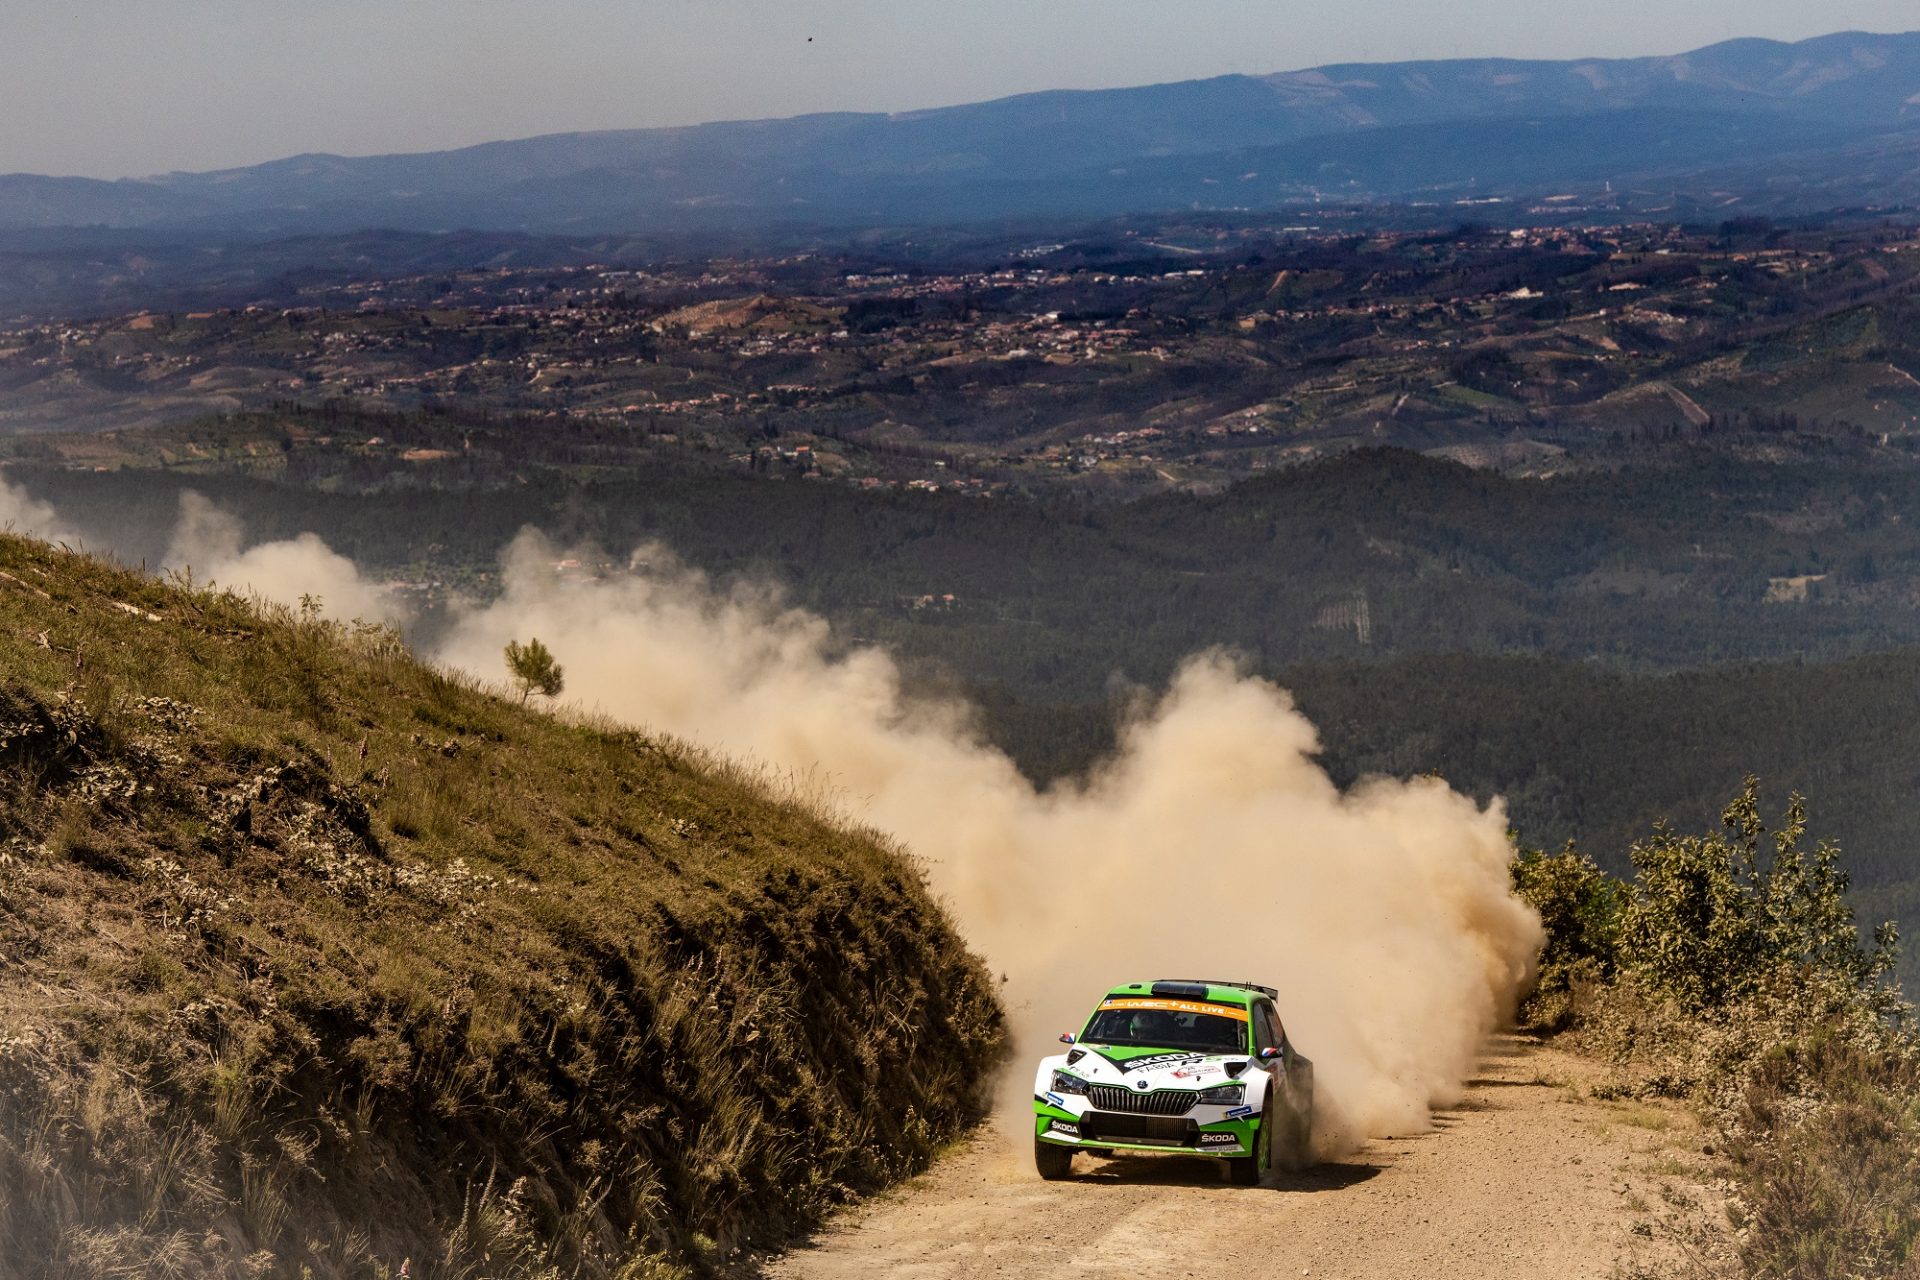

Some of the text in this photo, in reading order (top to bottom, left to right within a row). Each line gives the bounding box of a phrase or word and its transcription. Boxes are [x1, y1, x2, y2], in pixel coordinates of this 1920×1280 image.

[1179, 1003, 1196, 1011] ALL
[1202, 1006, 1224, 1015] LIVE
[1051, 1120, 1079, 1134] ŠKODA
[1201, 1133, 1236, 1143] ŠKODA
